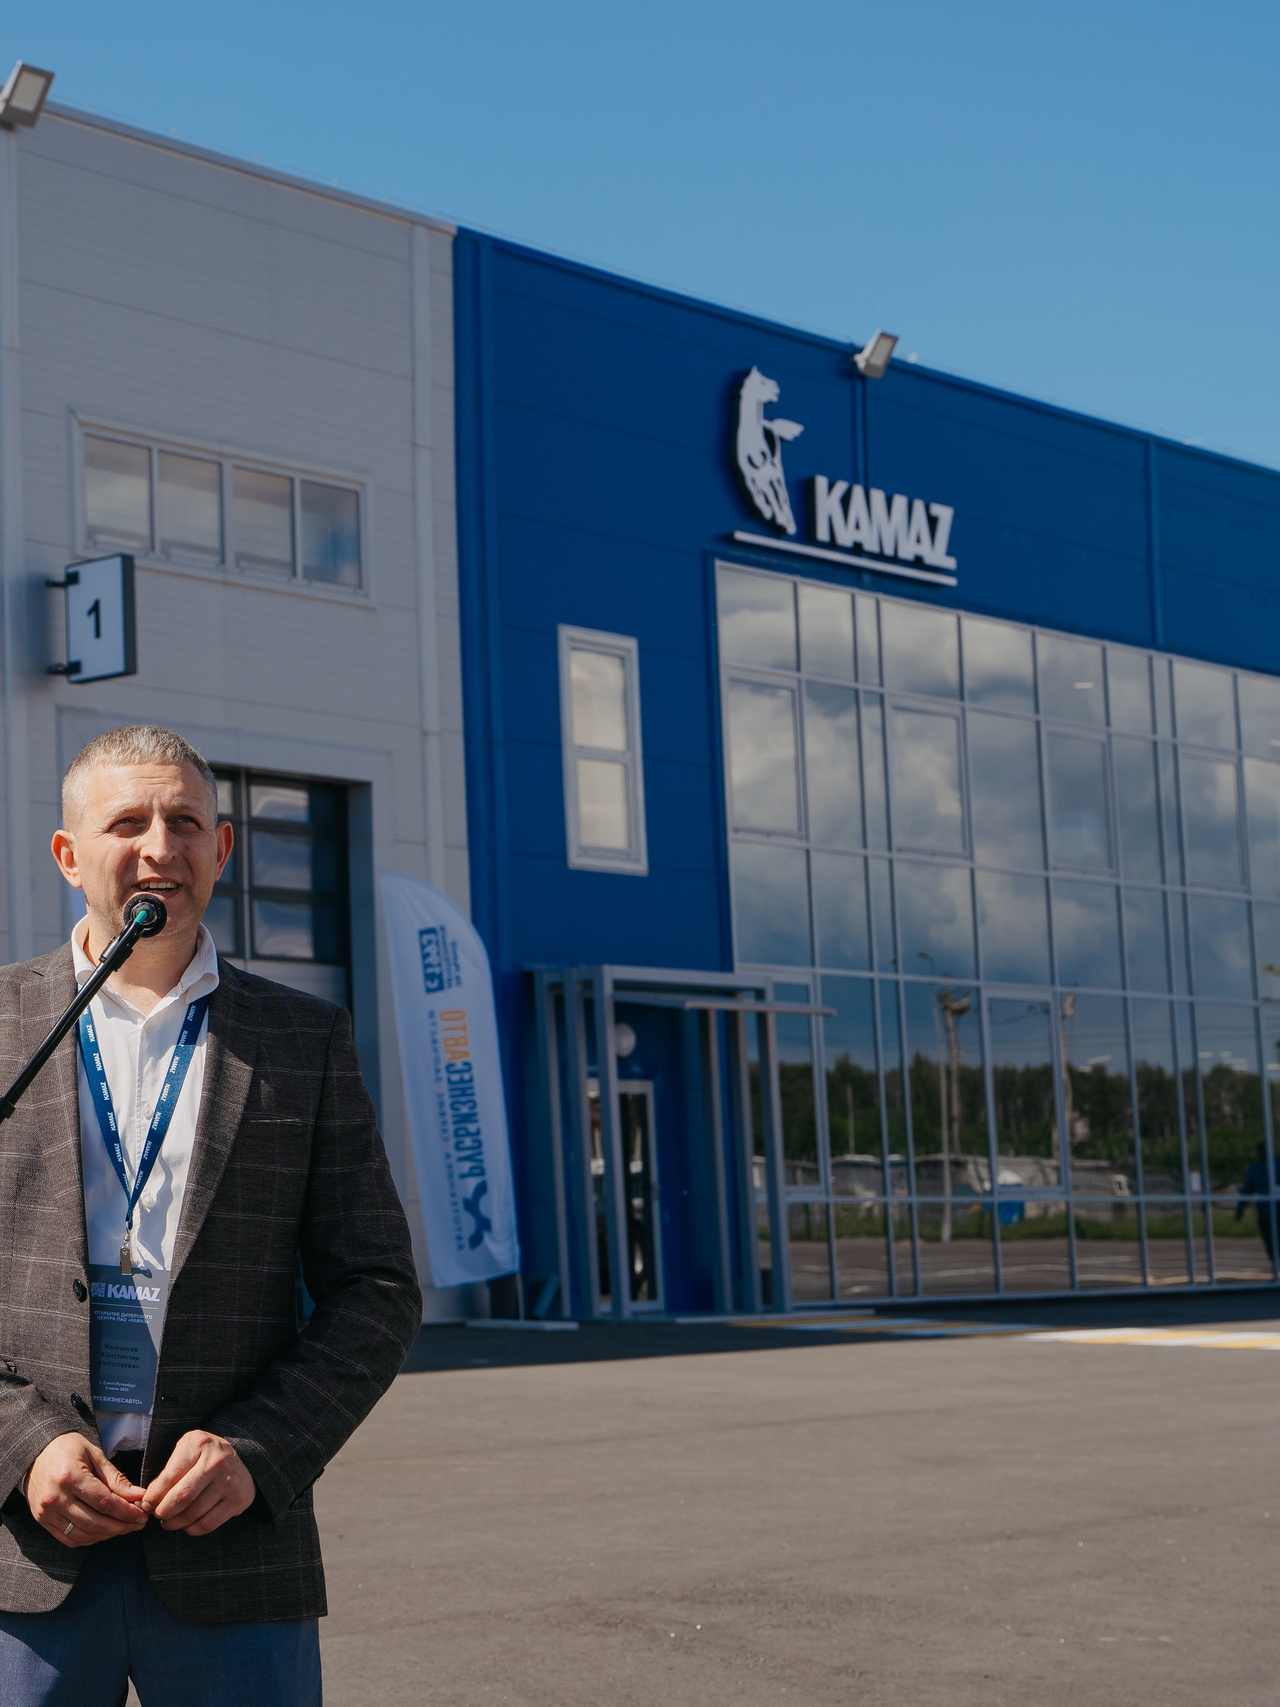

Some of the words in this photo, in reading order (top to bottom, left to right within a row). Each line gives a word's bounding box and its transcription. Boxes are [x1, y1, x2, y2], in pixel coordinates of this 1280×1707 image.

[814, 474, 958, 571] KAMAZ
[86, 598, 101, 639] 1
[86, 1024, 96, 1043] KAMAZ
[93, 1052, 103, 1071] KAMAZ
[169, 1055, 180, 1074] KAMAZ
[100, 1081, 110, 1101] KAMAZ
[161, 1083, 171, 1102] KAMAZ
[107, 1111, 117, 1131] KAMAZ
[151, 1111, 162, 1131] KAMAZ
[114, 1142, 123, 1163] KAMAZ
[143, 1140, 152, 1161] KAMAZ
[107, 1283, 161, 1302] KAMAZ
[99, 1361, 140, 1370] Николаевич
[100, 1351, 140, 1361] Константин
